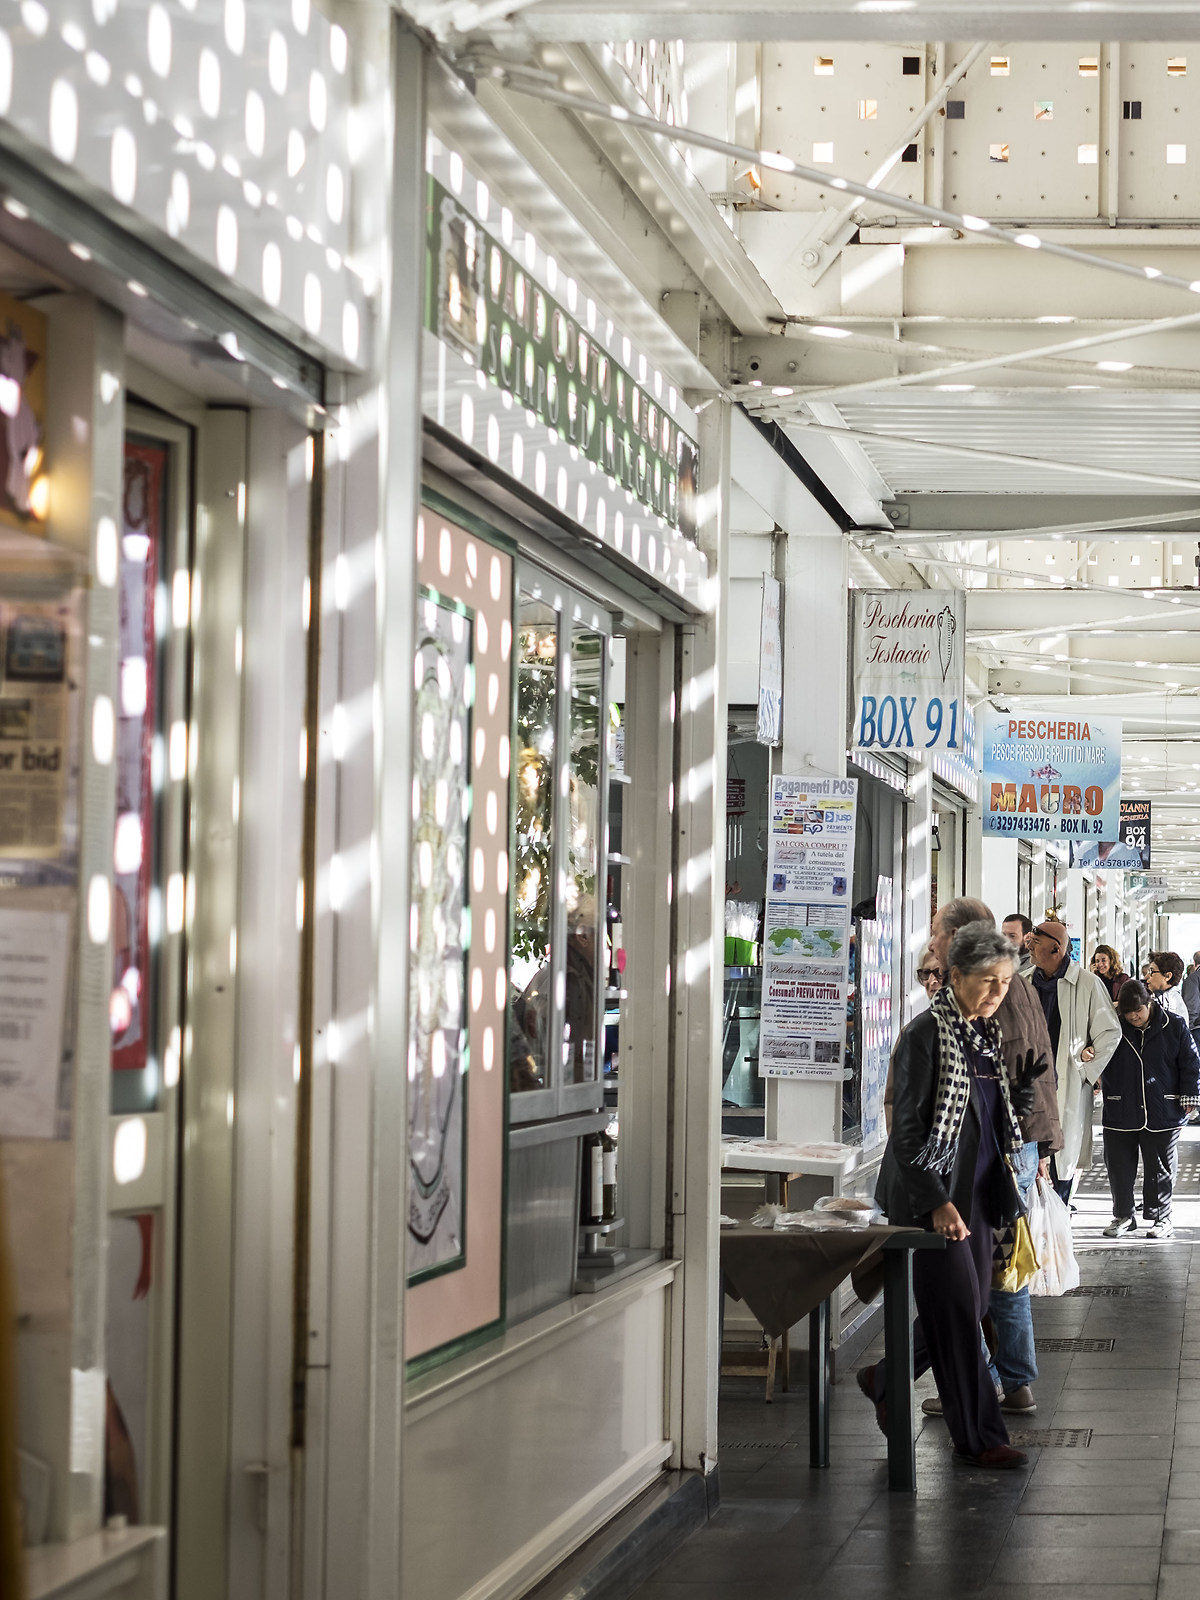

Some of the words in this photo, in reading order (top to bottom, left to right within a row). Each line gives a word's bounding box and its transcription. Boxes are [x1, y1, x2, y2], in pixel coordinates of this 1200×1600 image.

[552, 308, 611, 406] COTTO
[863, 600, 936, 629] Pescheria
[867, 635, 931, 664] Testaccio
[858, 696, 917, 748] BOX
[925, 698, 958, 748] 91
[1008, 720, 1091, 741] PESCHERIA
[992, 743, 1015, 761] PESCE
[1017, 744, 1044, 762] FRESCO
[1046, 745, 1051, 762] E
[1052, 745, 1077, 763] FRUTTI
[1077, 746, 1084, 763] DI
[1086, 747, 1106, 764] MARE
[775, 778, 830, 795] Pagamenti
[833, 780, 855, 795] POS
[990, 783, 1104, 816] MAURO
[996, 816, 1050, 832] 3297453476
[1060, 818, 1079, 833] BOX
[1081, 819, 1090, 833] N.
[1093, 820, 1103, 834] 92
[1126, 826, 1146, 835] BOX
[1125, 835, 1146, 850] 94
[1078, 859, 1092, 867] Tel.
[1095, 859, 1104, 867] 06
[1107, 859, 1142, 867] 5781639
[769, 986, 796, 998] Consumati
[796, 986, 815, 999] PREVIA
[816, 988, 840, 1000] COTTURA
